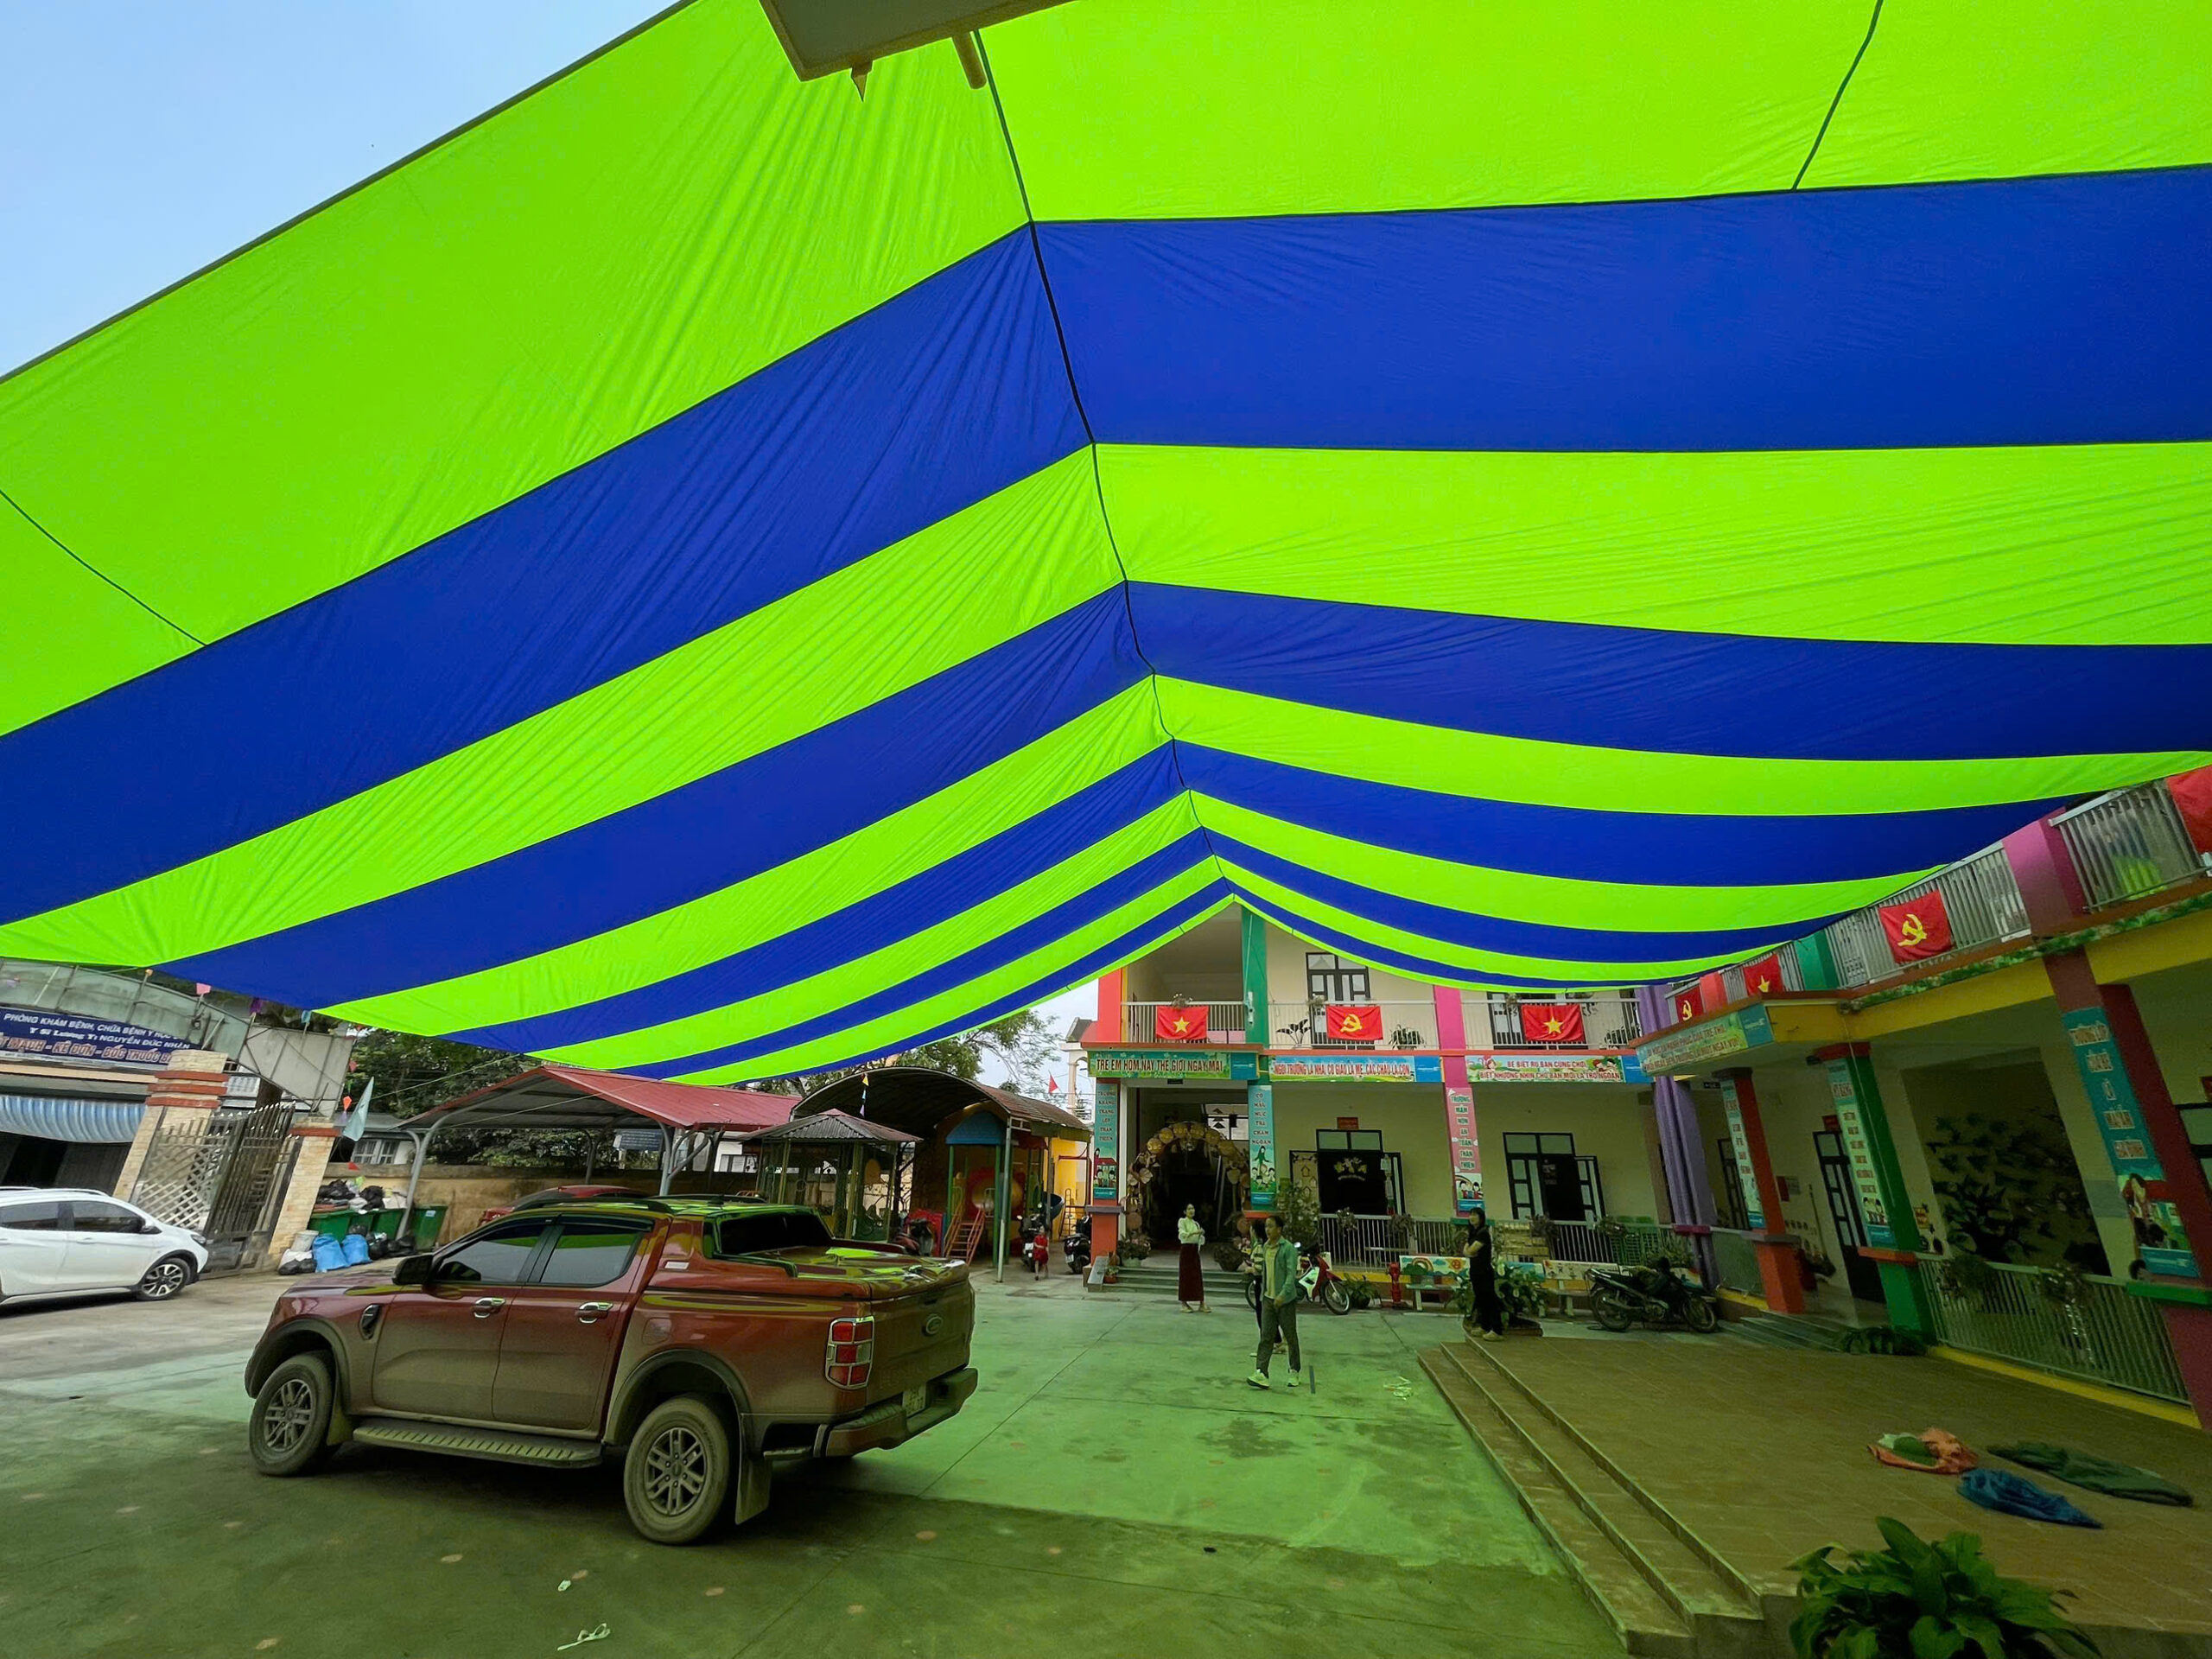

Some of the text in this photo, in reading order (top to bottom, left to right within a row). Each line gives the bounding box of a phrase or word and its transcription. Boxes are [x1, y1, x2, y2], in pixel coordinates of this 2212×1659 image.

[3, 1014, 39, 1024] PHÒNG
[40, 1018, 68, 1027] KHÁM
[125, 1048, 162, 1062] THUỐC
[1111, 1058, 1122, 1071] EM
[1141, 1058, 1154, 1071] NAY
